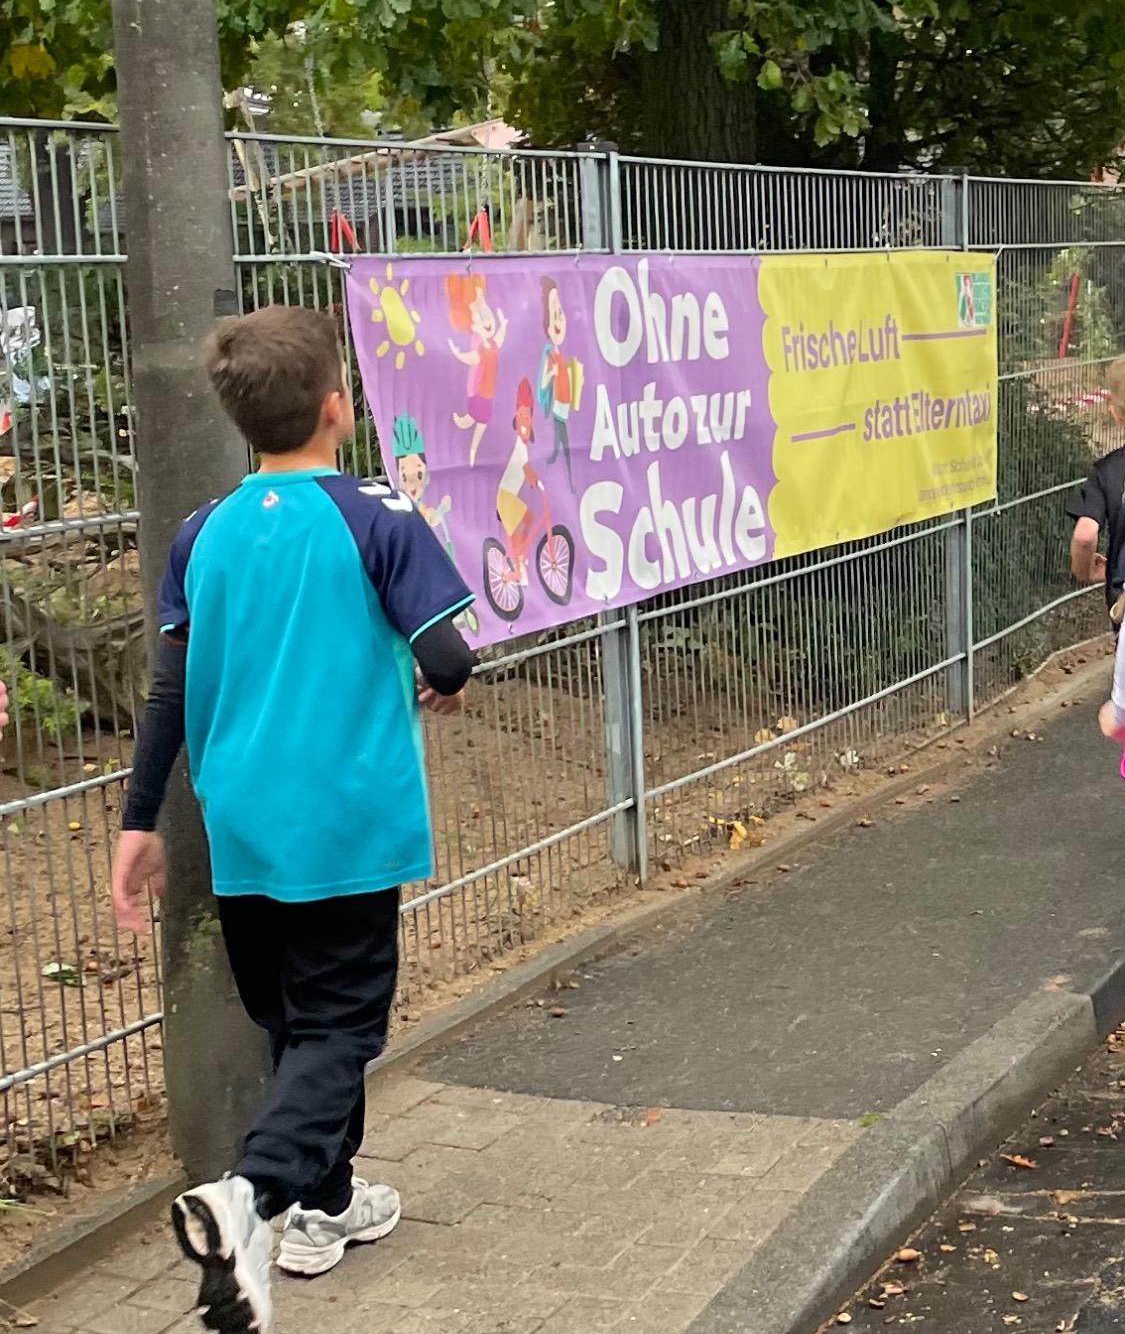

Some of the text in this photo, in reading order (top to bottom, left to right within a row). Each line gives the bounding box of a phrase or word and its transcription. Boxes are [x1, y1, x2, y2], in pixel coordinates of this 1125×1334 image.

[594, 257, 729, 367] Ohne
[782, 314, 900, 373] Frische Luft
[589, 382, 751, 461] Auto zur
[863, 382, 991, 442] statt Elterntaxi
[580, 450, 766, 600] Schule
